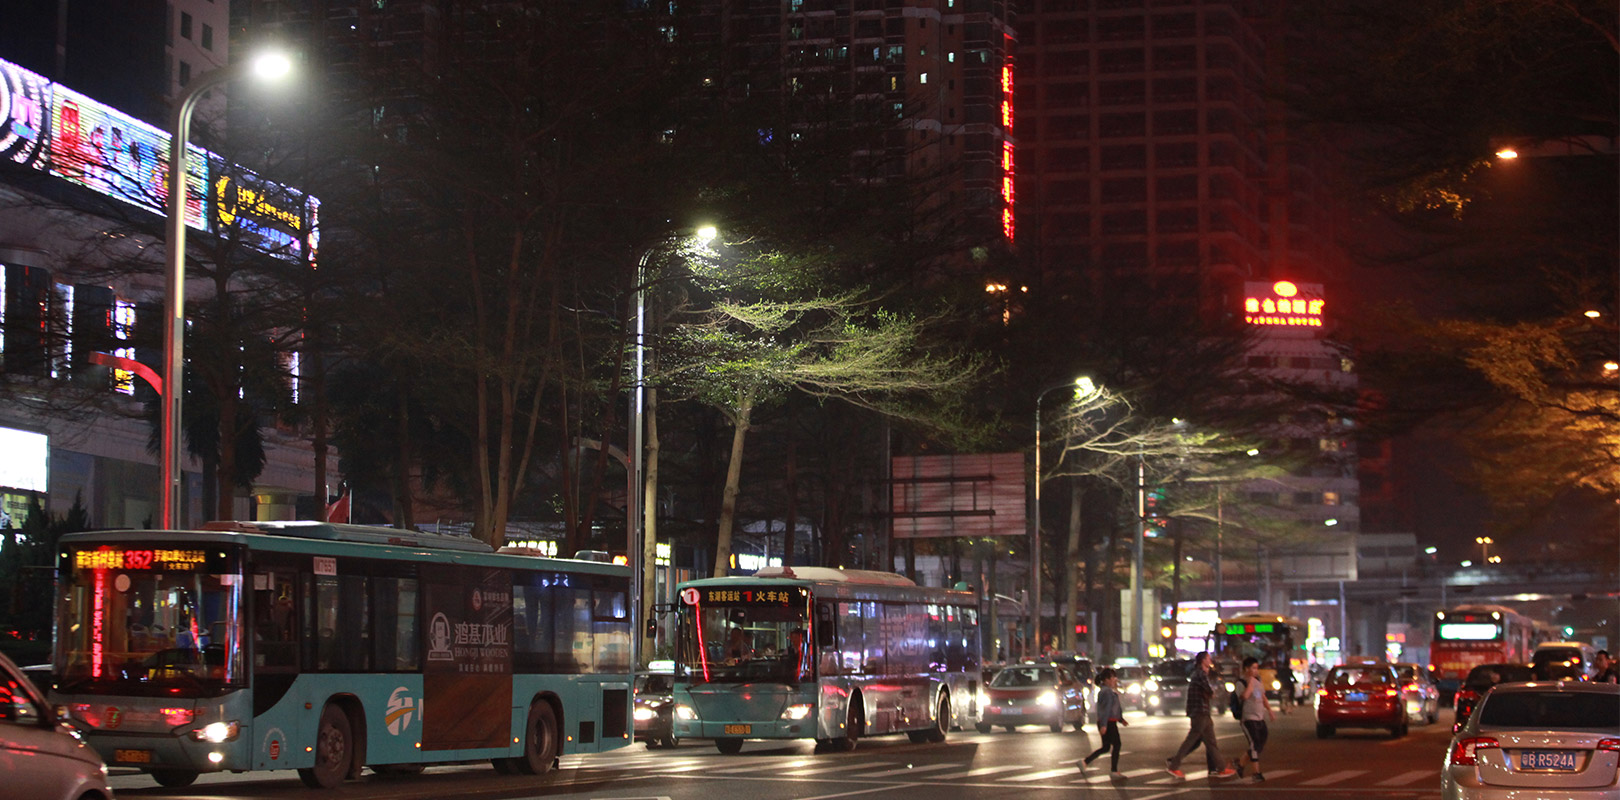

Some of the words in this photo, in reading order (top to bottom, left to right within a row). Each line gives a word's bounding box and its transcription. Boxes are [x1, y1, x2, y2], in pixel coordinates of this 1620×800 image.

[125, 550, 153, 570] 352
[743, 591, 753, 602] 1
[755, 590, 790, 603] 火车站
[480, 647, 508, 658] WOODEN
